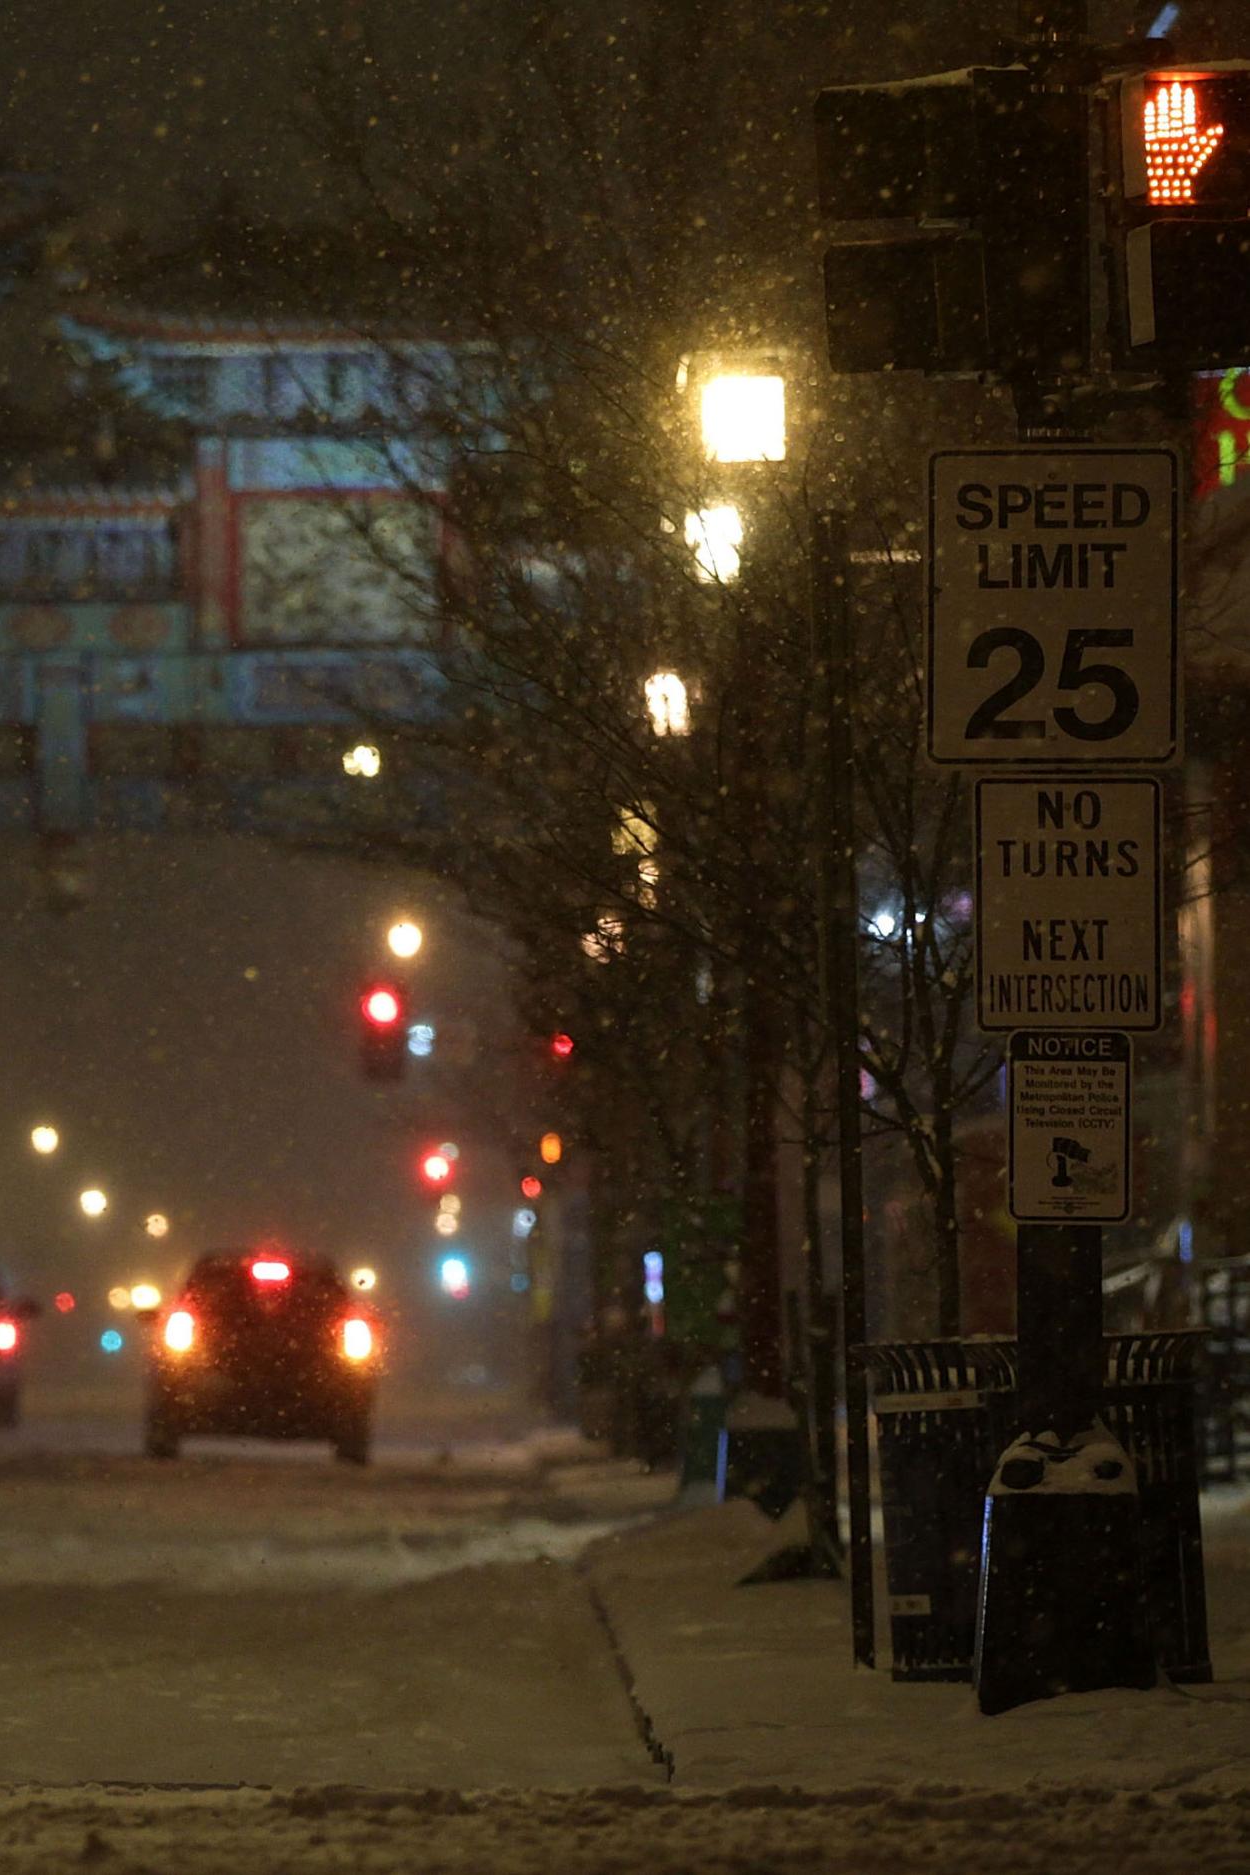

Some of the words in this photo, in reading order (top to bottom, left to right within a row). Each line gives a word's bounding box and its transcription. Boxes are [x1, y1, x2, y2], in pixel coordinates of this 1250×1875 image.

[956, 484, 1150, 530] SPEED
[978, 543, 1127, 588] LIMIT
[965, 627, 1139, 741] 25
[1038, 791, 1101, 829] NO
[997, 840, 1138, 877] TURNS
[1023, 920, 1108, 960] NEXT
[990, 974, 1148, 1012] INTERSECTION
[1028, 1037, 1112, 1056] NOTICE
[1025, 1065, 1045, 1075] This
[1051, 1065, 1072, 1075] Area
[1077, 1065, 1098, 1077] May
[1102, 1065, 1116, 1075] Be
[1026, 1080, 1077, 1089] Monitored
[1081, 1080, 1092, 1090] by
[1098, 1080, 1114, 1089] the
[1020, 1092, 1084, 1102] Metropolitan
[1088, 1092, 1119, 1102] Police
[1049, 1105, 1085, 1115] Closed
[1025, 1118, 1074, 1128] Television
[1078, 1118, 1115, 1128] (CCTV)
